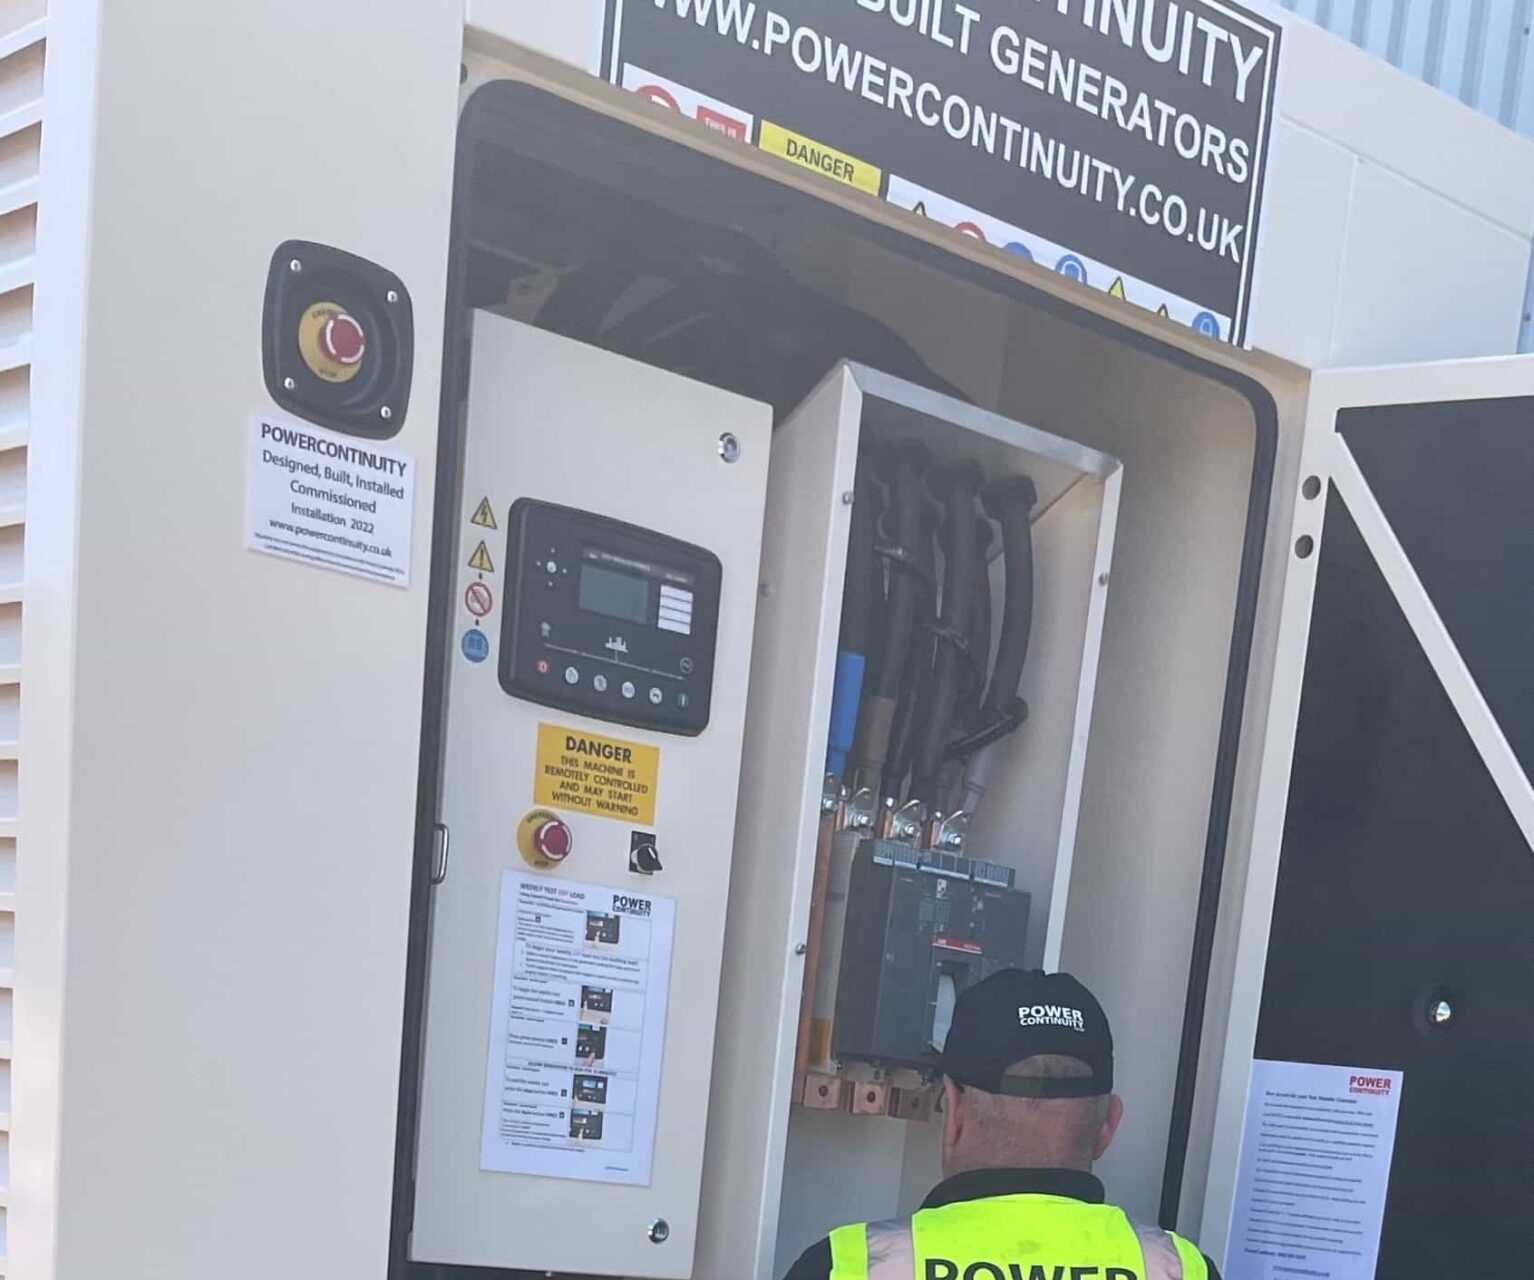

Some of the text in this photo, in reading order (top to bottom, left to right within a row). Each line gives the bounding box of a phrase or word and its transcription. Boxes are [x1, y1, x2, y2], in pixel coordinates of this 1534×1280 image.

[855, 0, 1249, 183] UILT GENERATORS
[654, 0, 1243, 263] WW.POWERCONTINUITY.CO.UK
[786, 138, 854, 181] DANGER
[261, 423, 406, 477] POWERCONTINUITY
[263, 450, 404, 499] Designed, Built, Installed
[290, 480, 376, 513] Commissioned
[292, 502, 374, 534] Installation 2022
[269, 519, 392, 557] www.powercontinuity.co.uk
[565, 736, 632, 764] DANGER
[544, 765, 648, 793] REMOTELY CONTROLLED
[561, 755, 635, 779] THIS MACHINE IS
[552, 791, 639, 816] WITHOUT WARNING
[560, 780, 633, 802] AND MAY START
[612, 905, 651, 917] CONTINUITY
[613, 895, 652, 910] POWER
[1018, 1005, 1083, 1022] POWER
[1020, 1016, 1083, 1029] CONTINUITY
[1349, 1076, 1391, 1089] POWER
